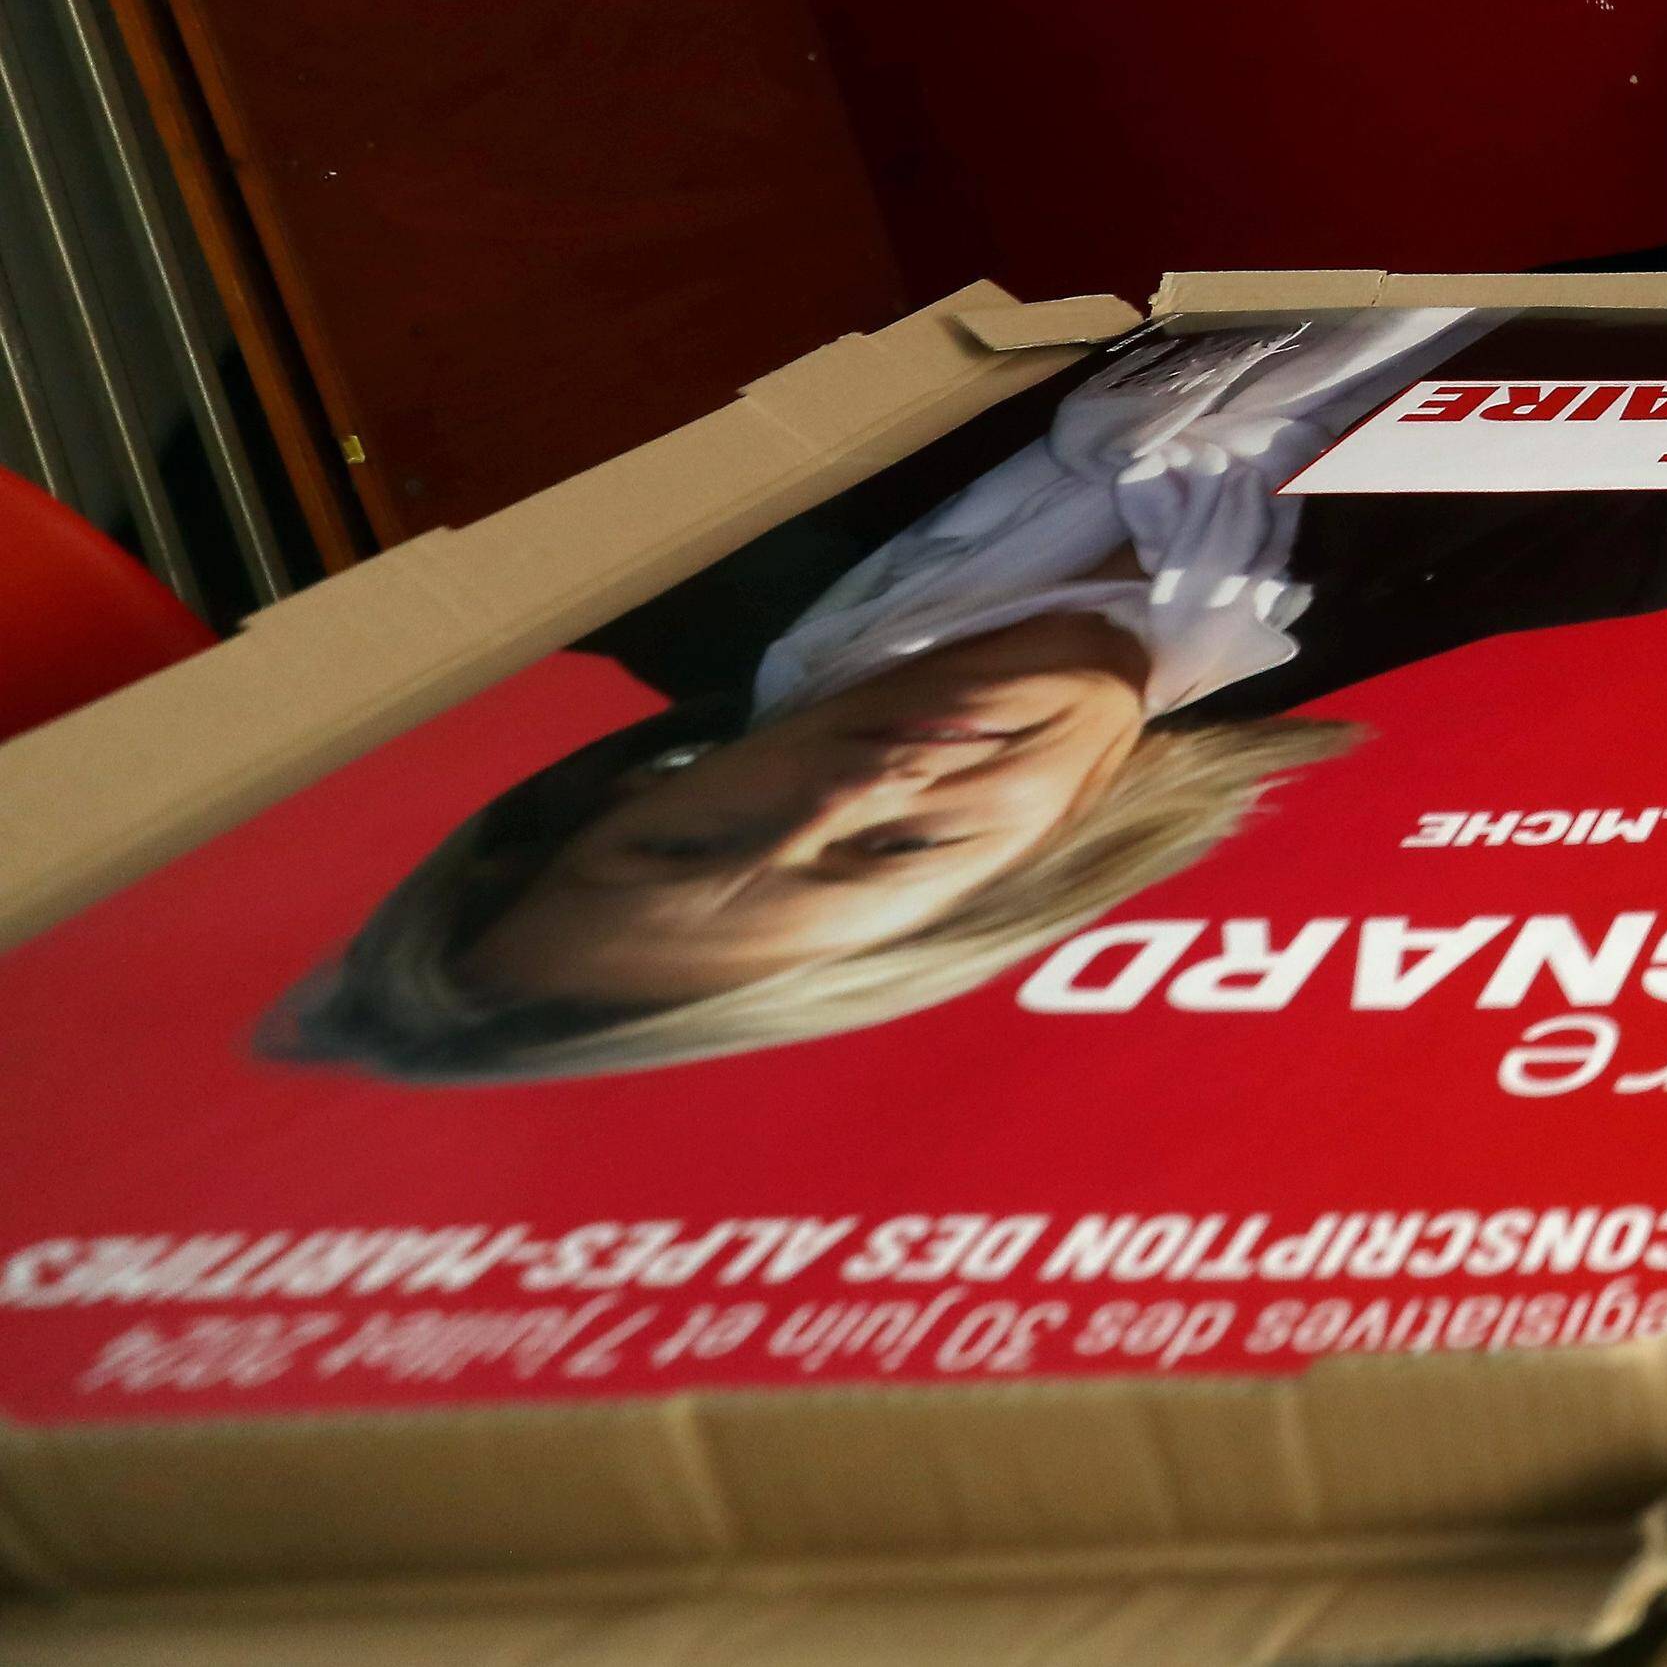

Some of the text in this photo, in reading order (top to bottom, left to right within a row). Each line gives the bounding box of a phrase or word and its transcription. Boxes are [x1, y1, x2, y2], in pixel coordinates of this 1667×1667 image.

[840, 1211, 1052, 1284] DES
[648, 1298, 770, 1368] et
[766, 1283, 971, 1374] juin
[934, 1297, 1070, 1376] 30
[1071, 1297, 1245, 1370] des
